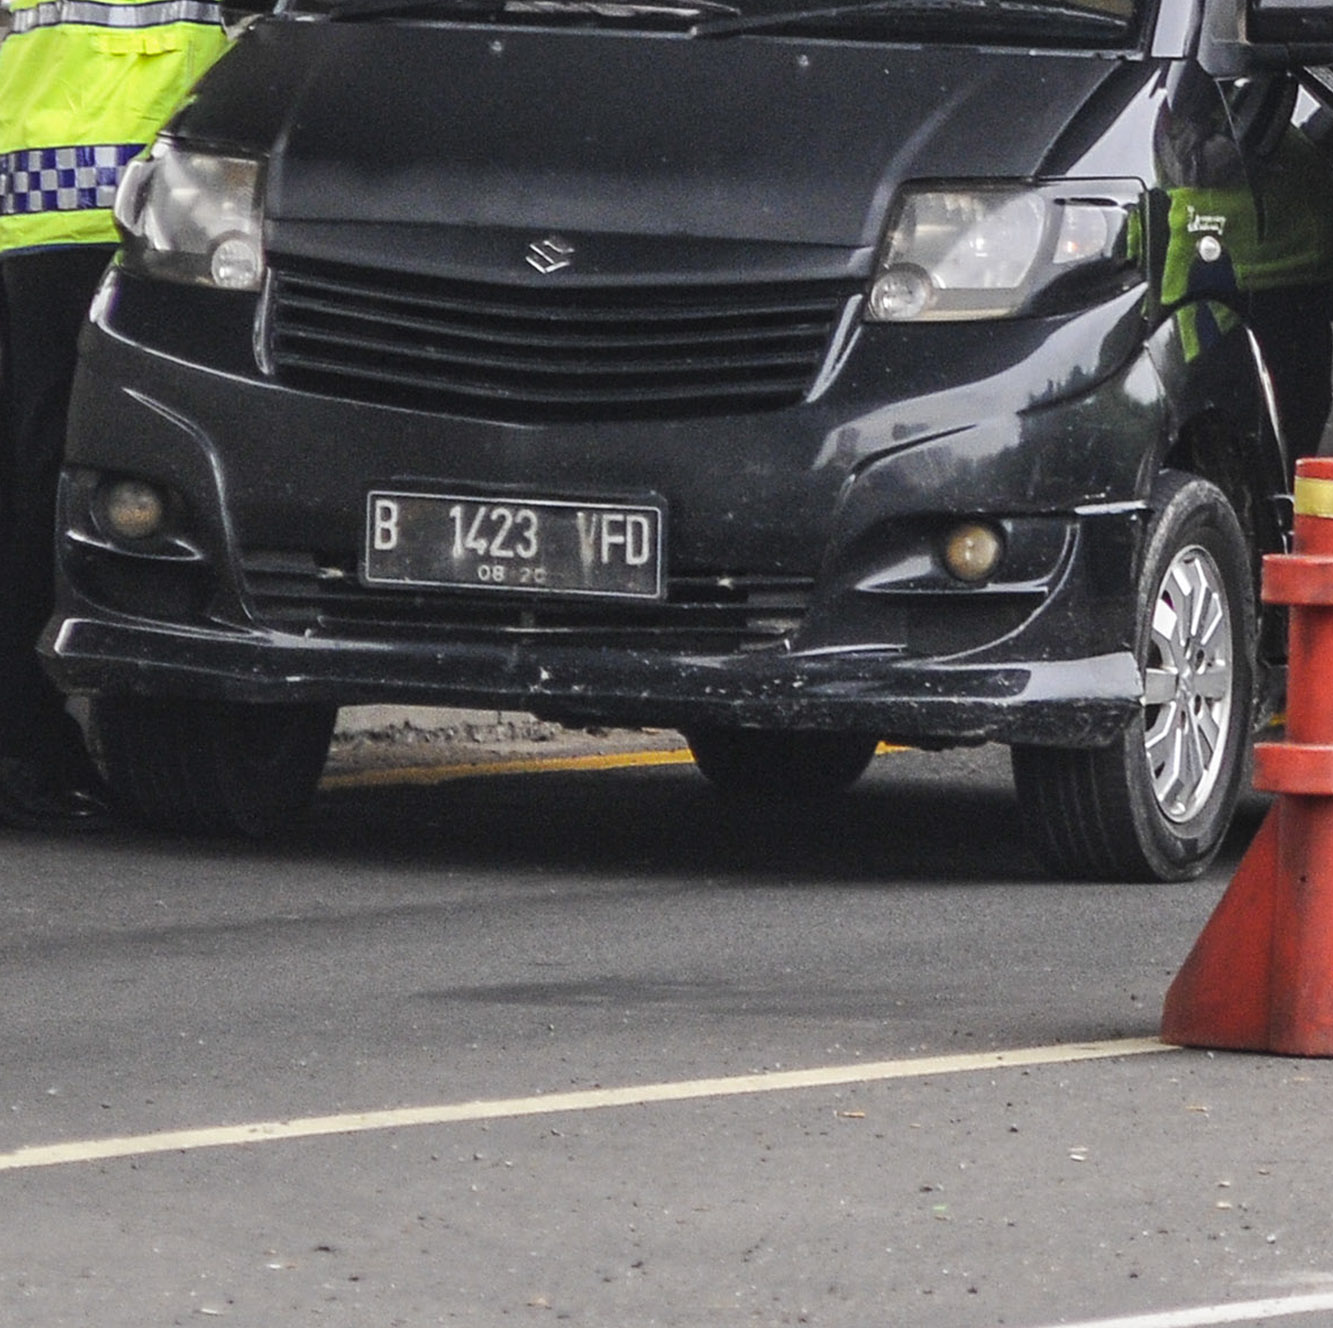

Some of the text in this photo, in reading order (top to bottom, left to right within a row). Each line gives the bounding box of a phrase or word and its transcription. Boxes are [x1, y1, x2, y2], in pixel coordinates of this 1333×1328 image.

[374, 499, 650, 566] B 1423 VFD
[478, 565, 505, 583] 08
